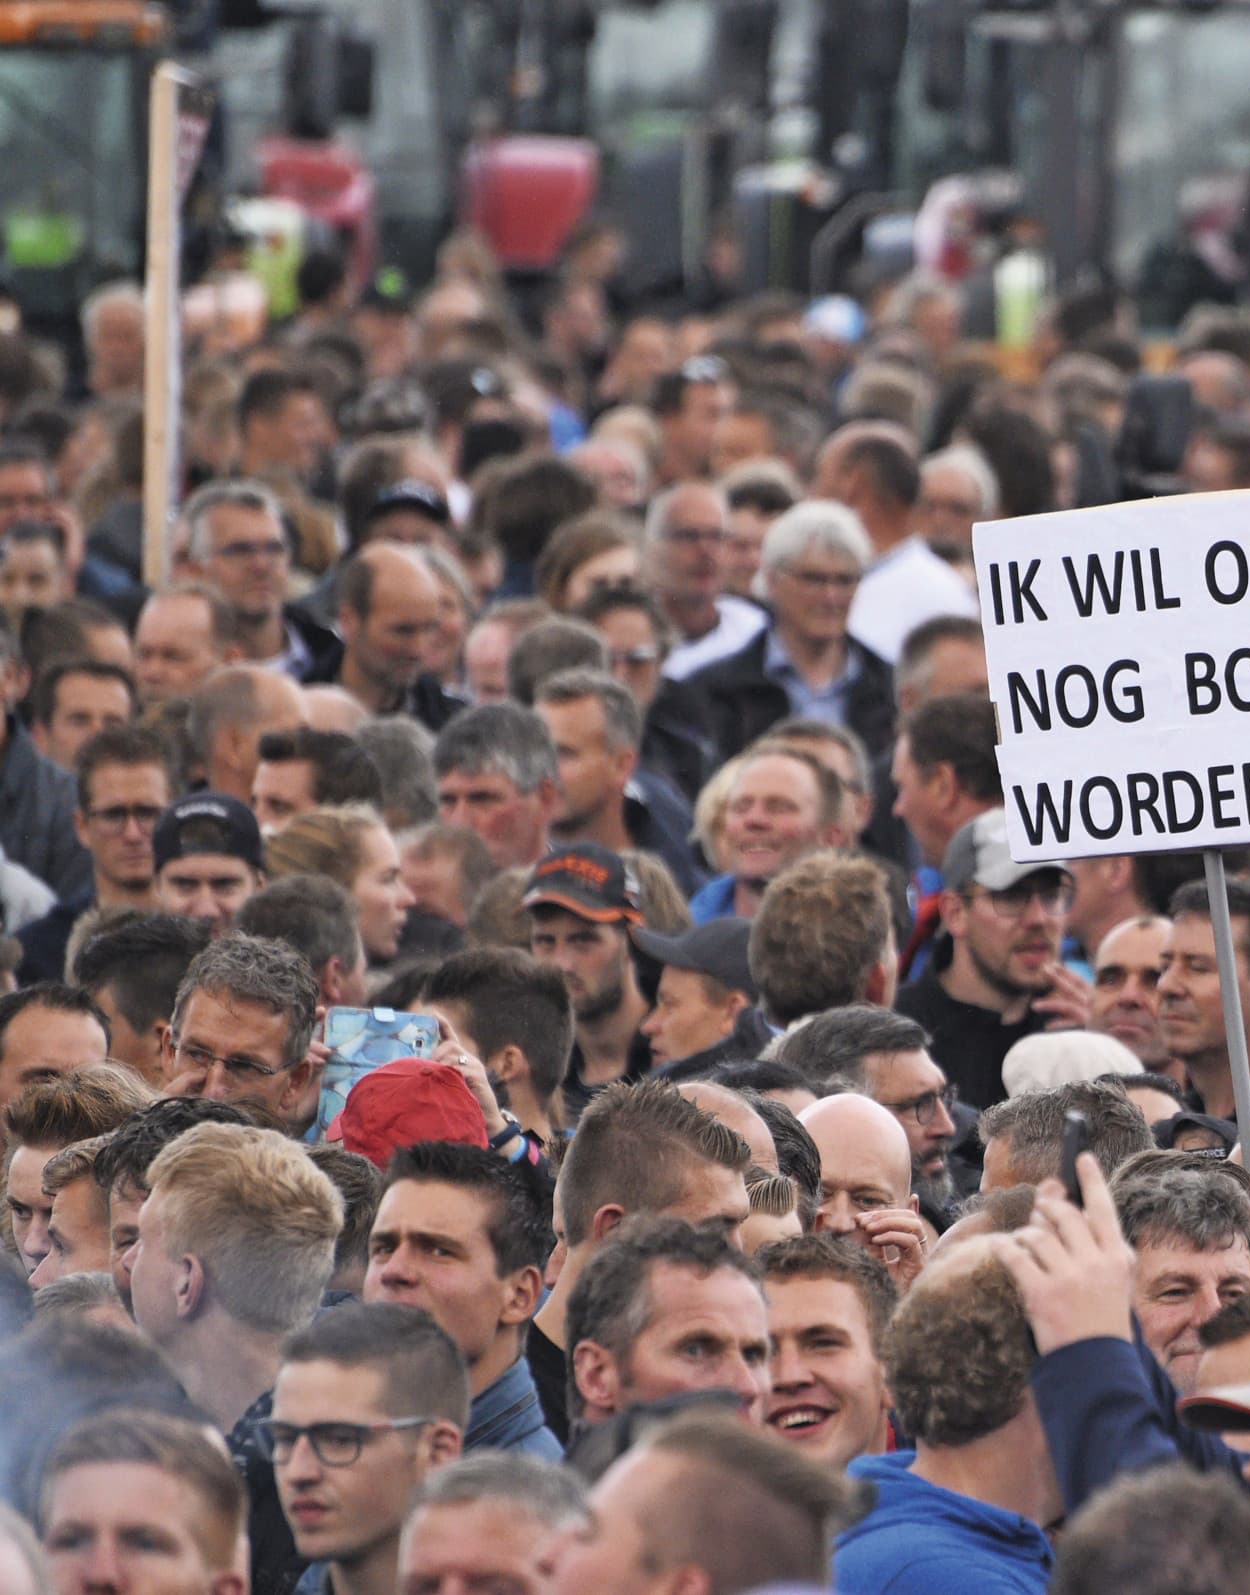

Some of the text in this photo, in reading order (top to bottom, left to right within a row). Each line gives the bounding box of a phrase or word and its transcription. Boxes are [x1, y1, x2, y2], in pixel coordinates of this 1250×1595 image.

[989, 558, 1049, 626] IK
[1061, 547, 1181, 618] WIL
[1007, 658, 1145, 735] NOG
